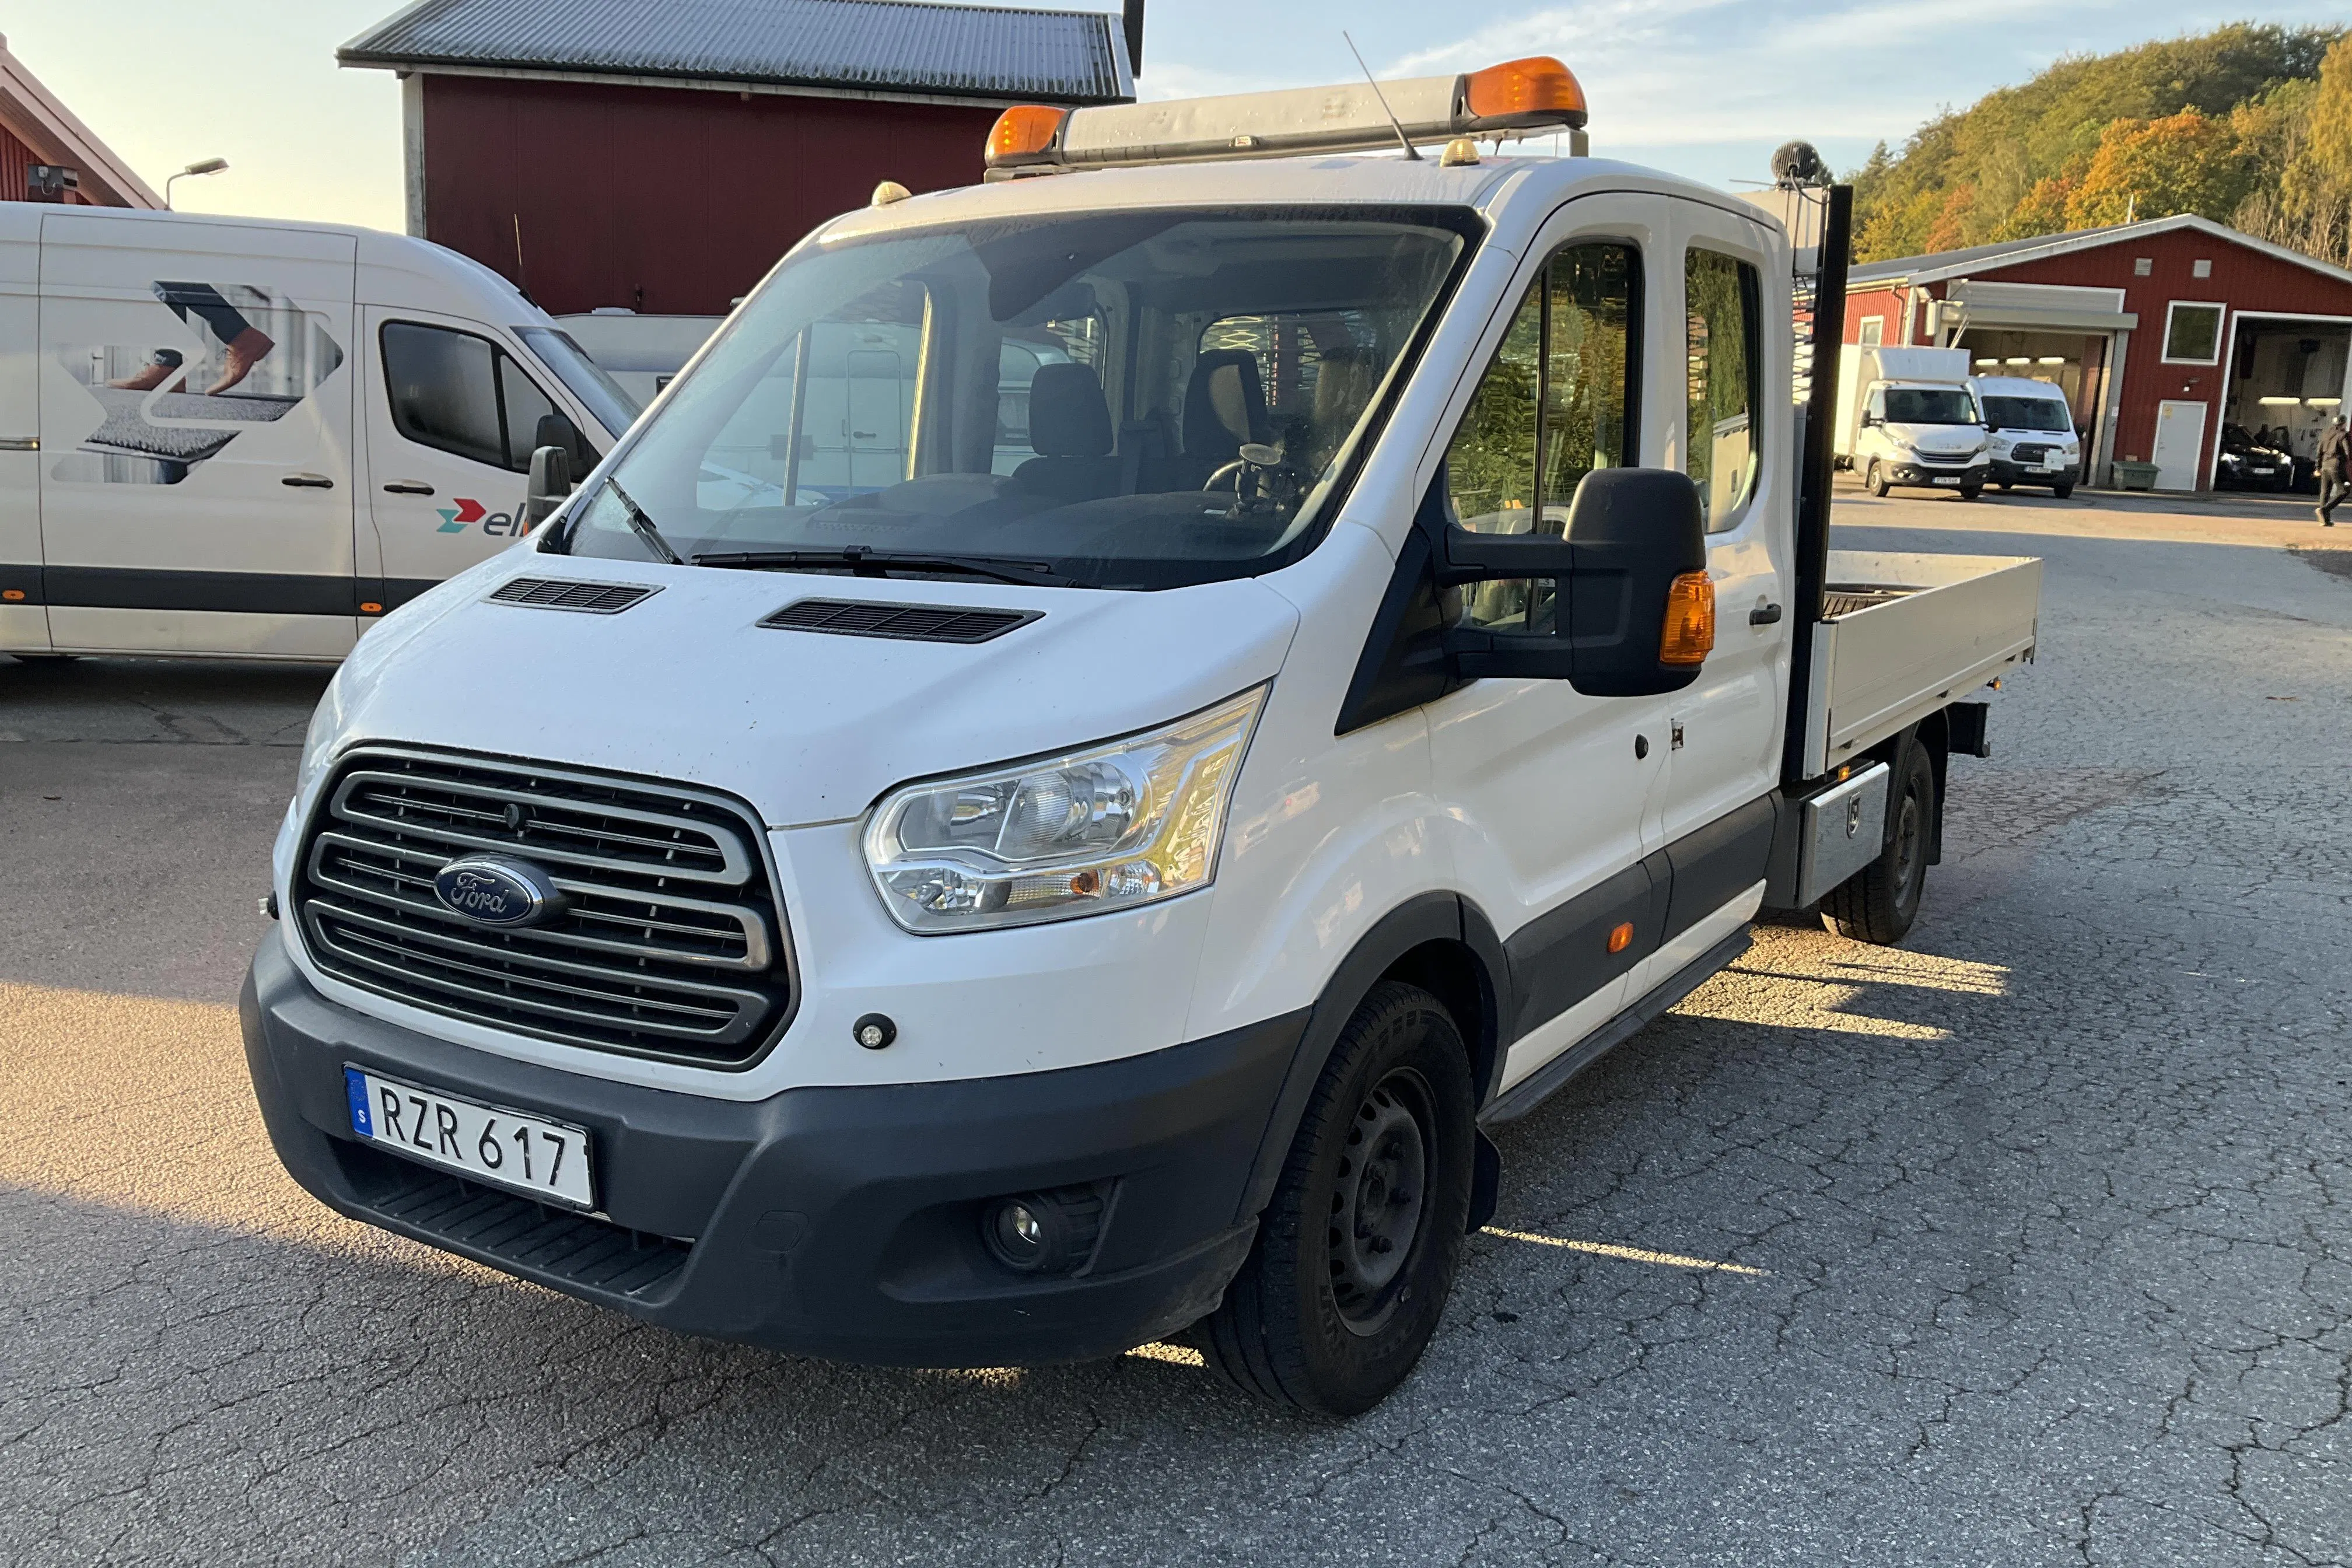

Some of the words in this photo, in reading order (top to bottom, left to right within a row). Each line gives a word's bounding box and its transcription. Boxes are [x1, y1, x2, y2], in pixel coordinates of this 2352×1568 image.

[450, 872, 509, 914] Ford
[358, 1109, 366, 1123] S
[380, 1086, 464, 1160] RZR
[478, 1118, 565, 1186] 617
